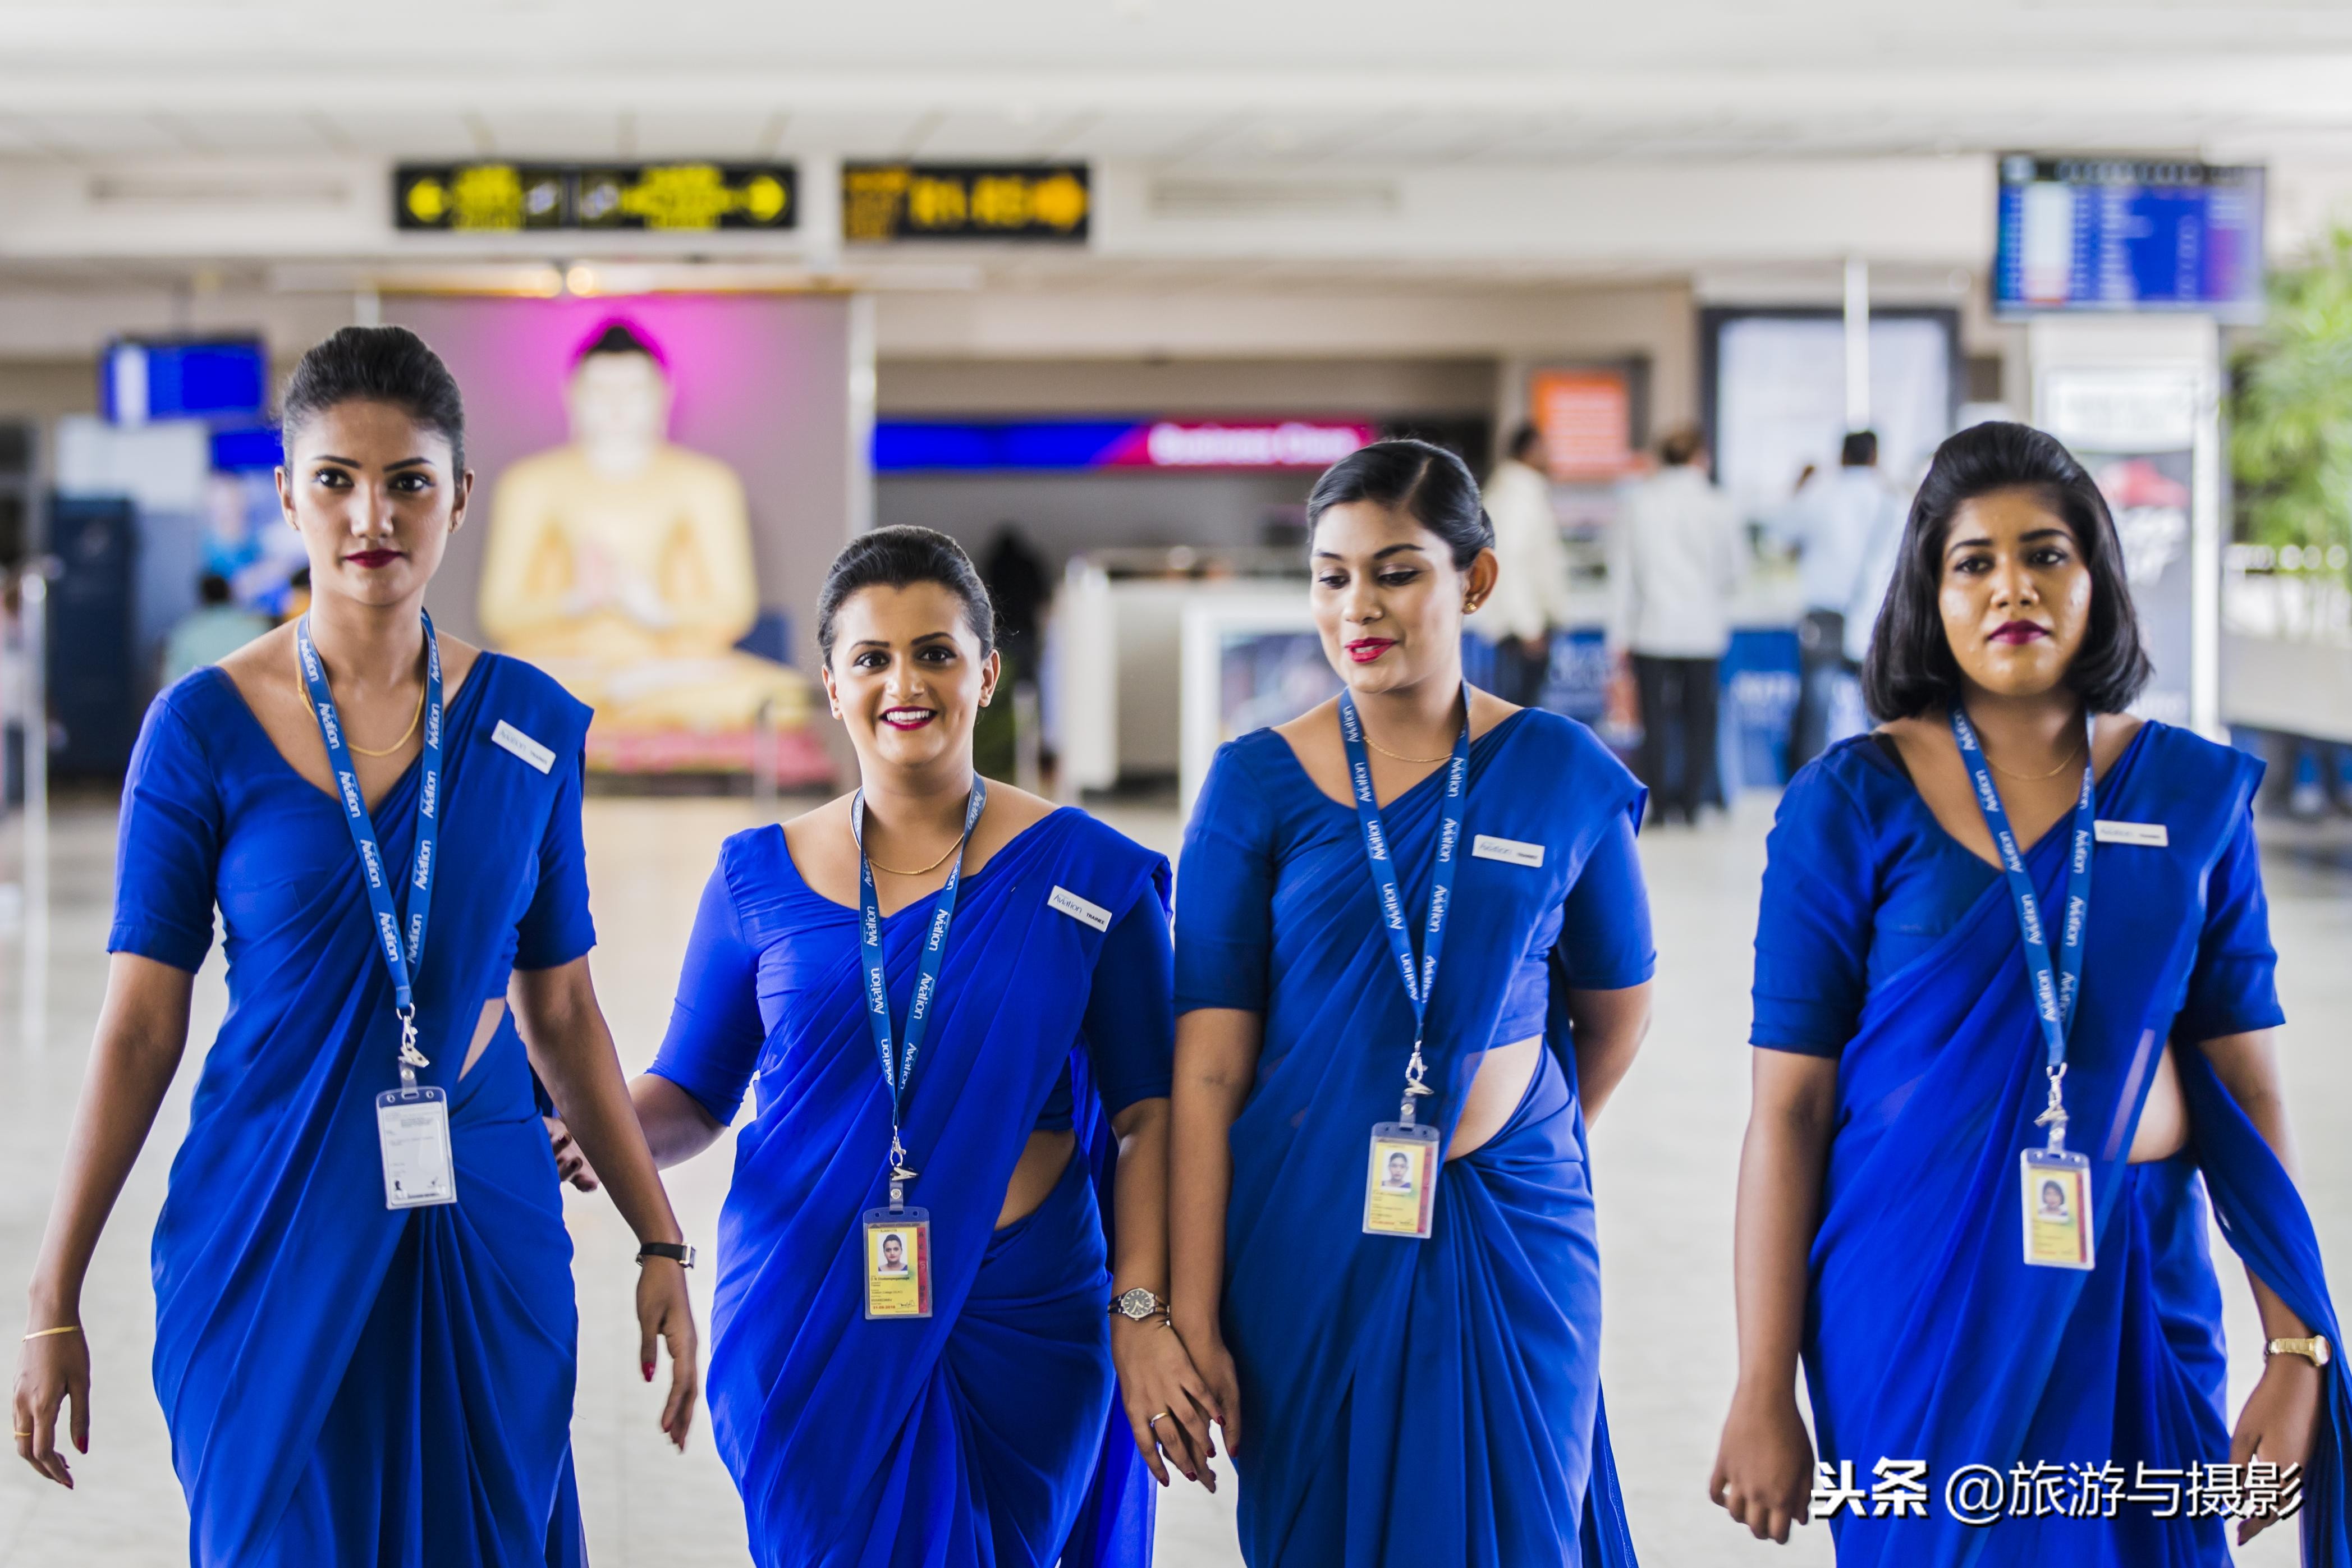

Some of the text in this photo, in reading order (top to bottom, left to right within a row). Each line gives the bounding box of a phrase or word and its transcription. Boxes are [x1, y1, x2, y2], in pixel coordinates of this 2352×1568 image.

[299, 638, 319, 682] Aviation
[318, 702, 341, 750] Aviation
[425, 703, 440, 750] Aviation
[1342, 704, 1360, 743] Aviation
[338, 771, 361, 818] Aviation
[420, 770, 437, 819] Aviation
[1354, 762, 1373, 803] Aviation
[1448, 757, 1465, 798] Aviation
[1975, 768, 2000, 813] Aviation
[968, 790, 984, 831] Aviation
[360, 839, 382, 888] Aviation
[1367, 819, 1388, 861] Aviation
[1438, 817, 1458, 863] Aviation
[1998, 830, 2024, 873] Aviation
[2073, 829, 2090, 874] Aviation
[412, 840, 432, 891] Aviation
[866, 905, 878, 947] Aviation
[928, 908, 949, 951] Aviation
[1053, 894, 1105, 925] Aviation TRAINEE
[1382, 882, 1405, 930] Aviation
[1428, 884, 1448, 933] Aviation
[2020, 893, 2043, 946] Aviation
[2065, 895, 2085, 948] Aviation
[378, 911, 399, 962] Aviation
[406, 914, 423, 964] Aviation
[870, 967, 886, 1015] Aviation
[913, 971, 933, 1020] Aviation
[1400, 953, 1419, 1001] Aviation
[2037, 969, 2057, 1023] Aviation
[880, 1038, 893, 1086] Aviation
[900, 1042, 918, 1090] Aviation
